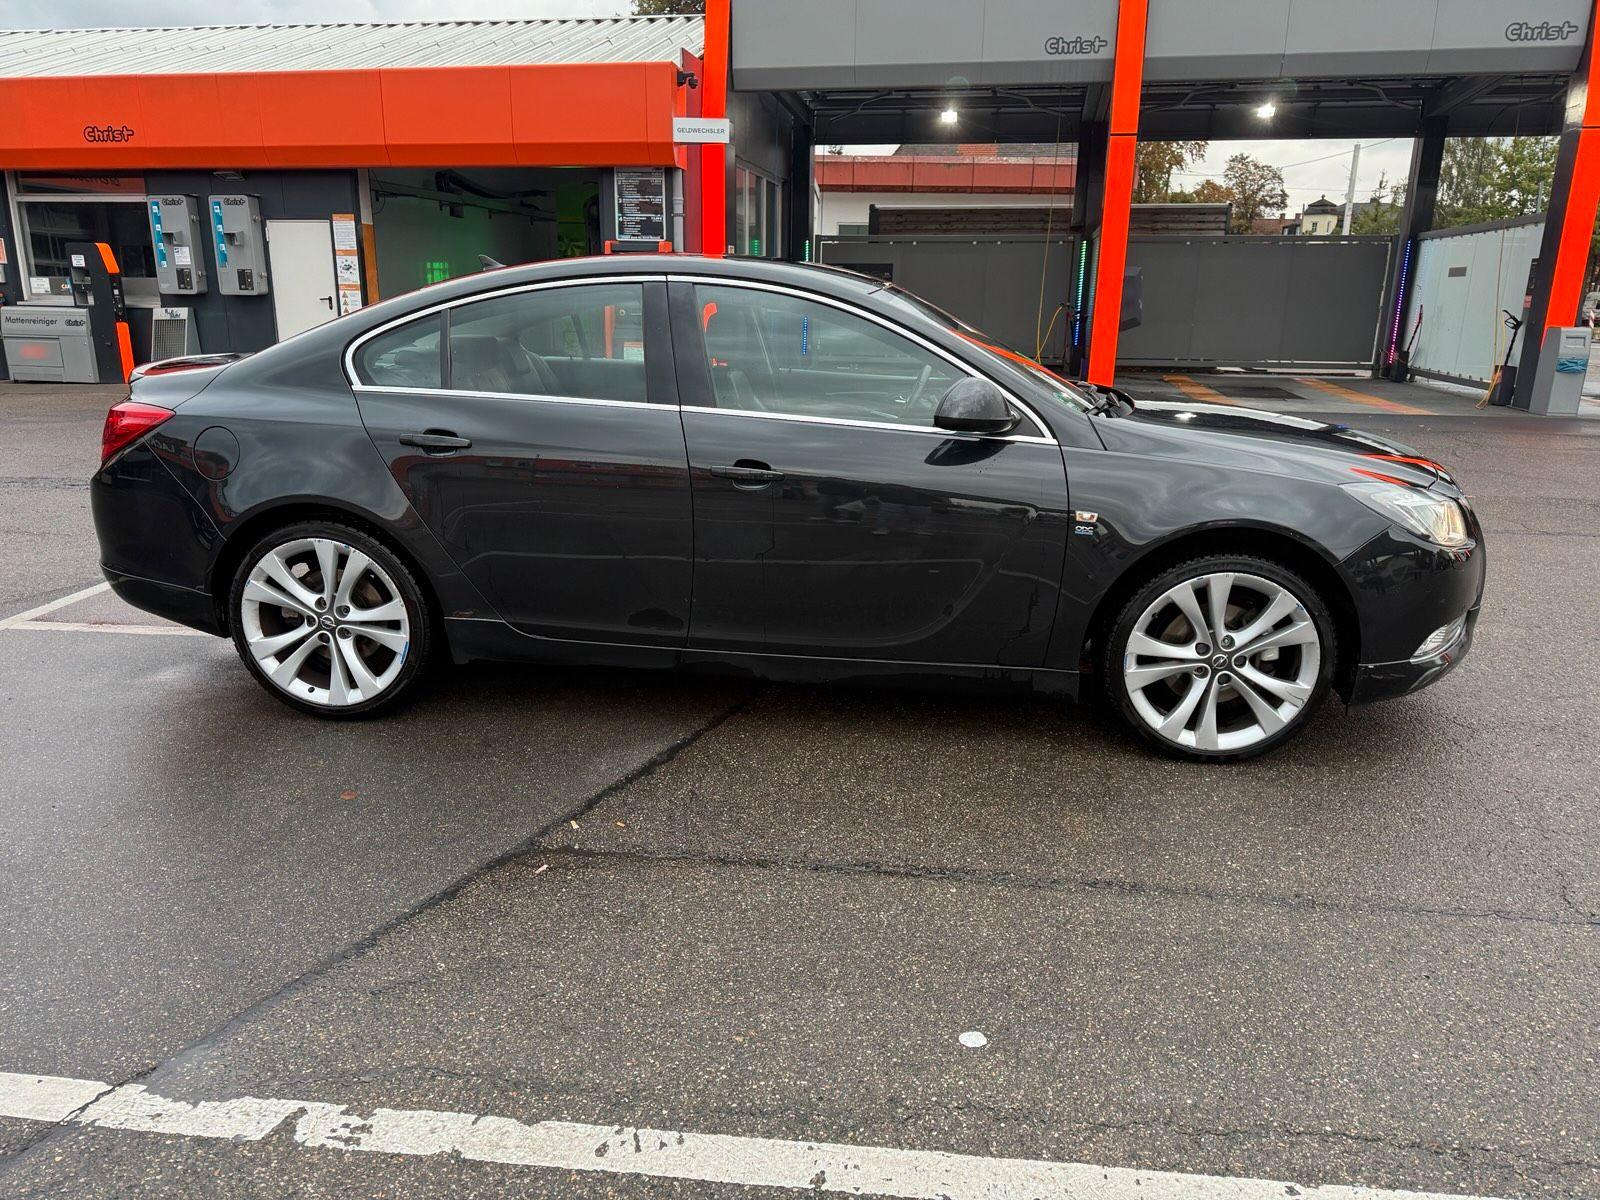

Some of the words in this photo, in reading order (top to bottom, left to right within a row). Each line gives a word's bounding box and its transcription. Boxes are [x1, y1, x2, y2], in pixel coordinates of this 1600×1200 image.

[1506, 22, 1578, 41] Christ
[1046, 37, 1107, 54] Christ
[84, 126, 134, 142] Christ
[676, 126, 726, 135] GELDWECHSLER
[161, 198, 184, 206] Christ
[223, 198, 246, 206] Christ
[5, 316, 58, 326] Mattenreiniger
